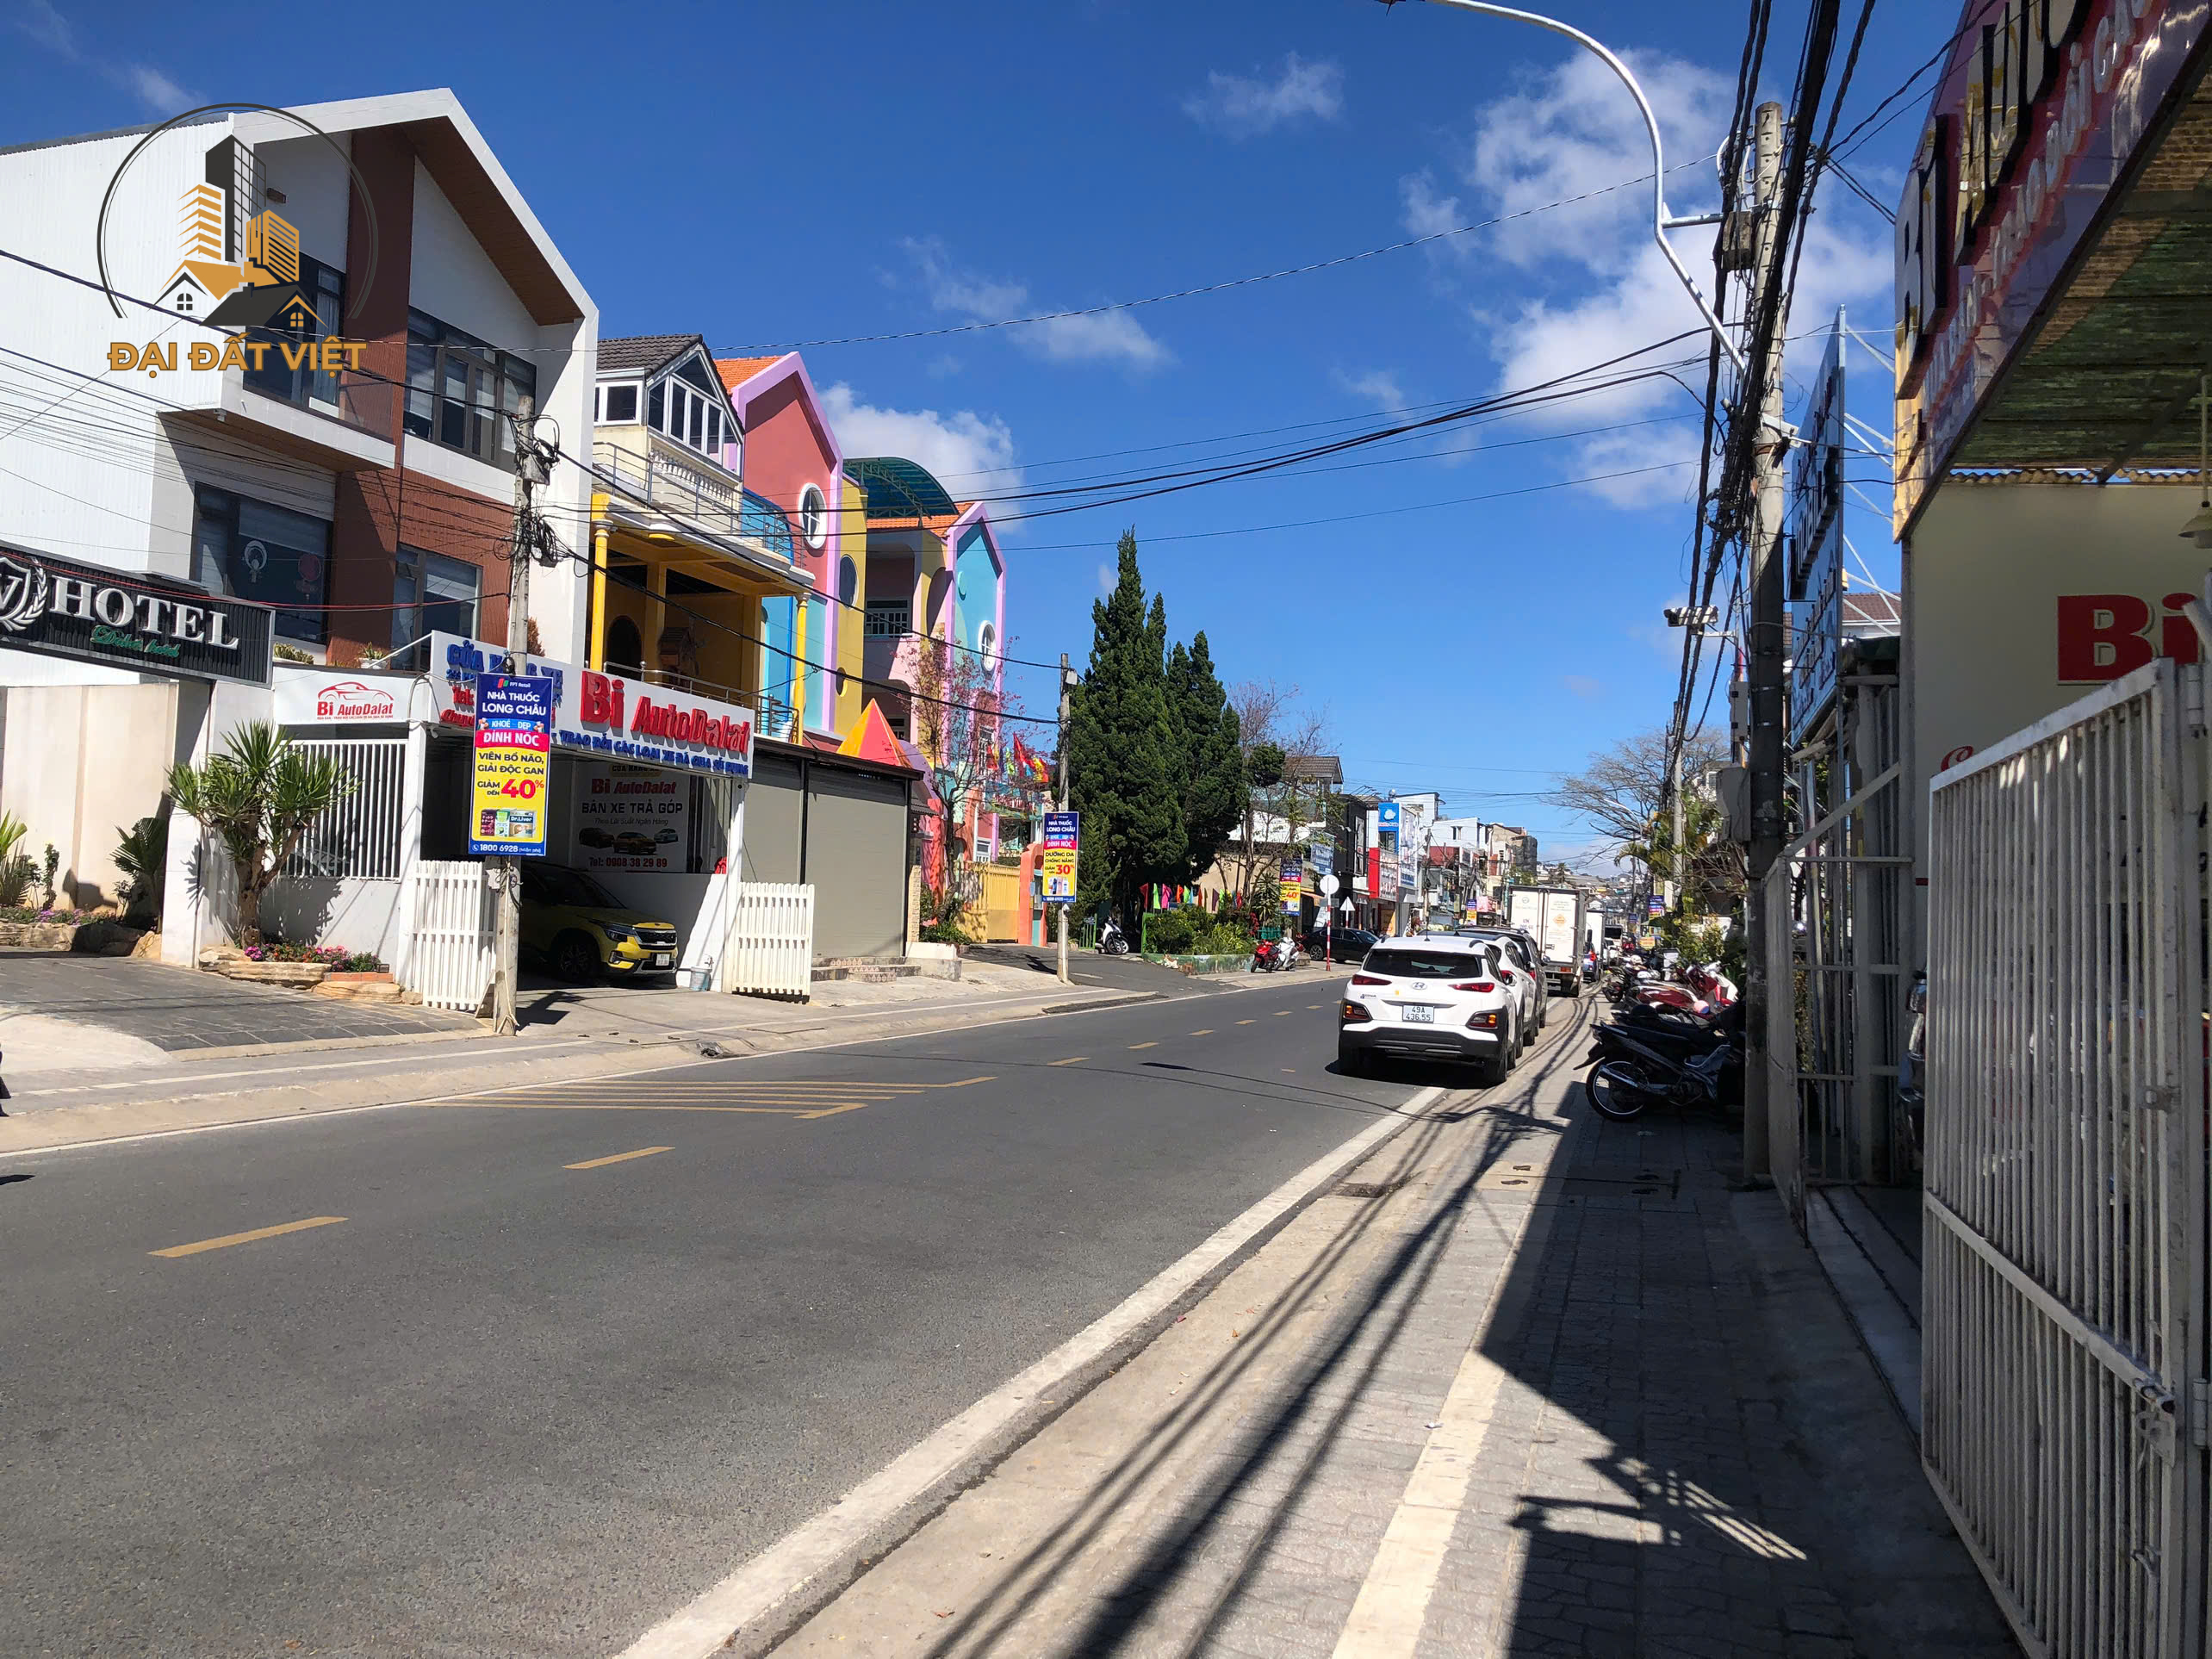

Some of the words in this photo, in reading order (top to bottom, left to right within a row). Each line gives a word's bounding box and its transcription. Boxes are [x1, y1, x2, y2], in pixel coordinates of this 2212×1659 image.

[49, 575, 239, 649] HOTEL
[487, 690, 506, 700] NHÀ
[508, 691, 540, 702] THUỐC
[317, 701, 333, 716] Bi
[338, 703, 394, 716] AutoDalat
[482, 702, 514, 714] LONG
[516, 704, 546, 716] CHÂU
[581, 670, 624, 728] Bi
[630, 696, 750, 754] AutoDalat
[559, 730, 591, 745] TRAO
[479, 751, 501, 761] VIÊN
[477, 762, 497, 773] GIẢI
[500, 765, 521, 774] ĐỘC
[477, 780, 500, 788] GIẢM
[500, 779, 544, 799] 40%
[592, 778, 611, 794] Bi
[614, 780, 677, 794] AutoDalat
[581, 799, 606, 814] BÁN
[610, 803, 625, 814] XE
[630, 798, 654, 814] TRẢ
[658, 798, 683, 814] GÓP
[500, 844, 519, 853] 6928
